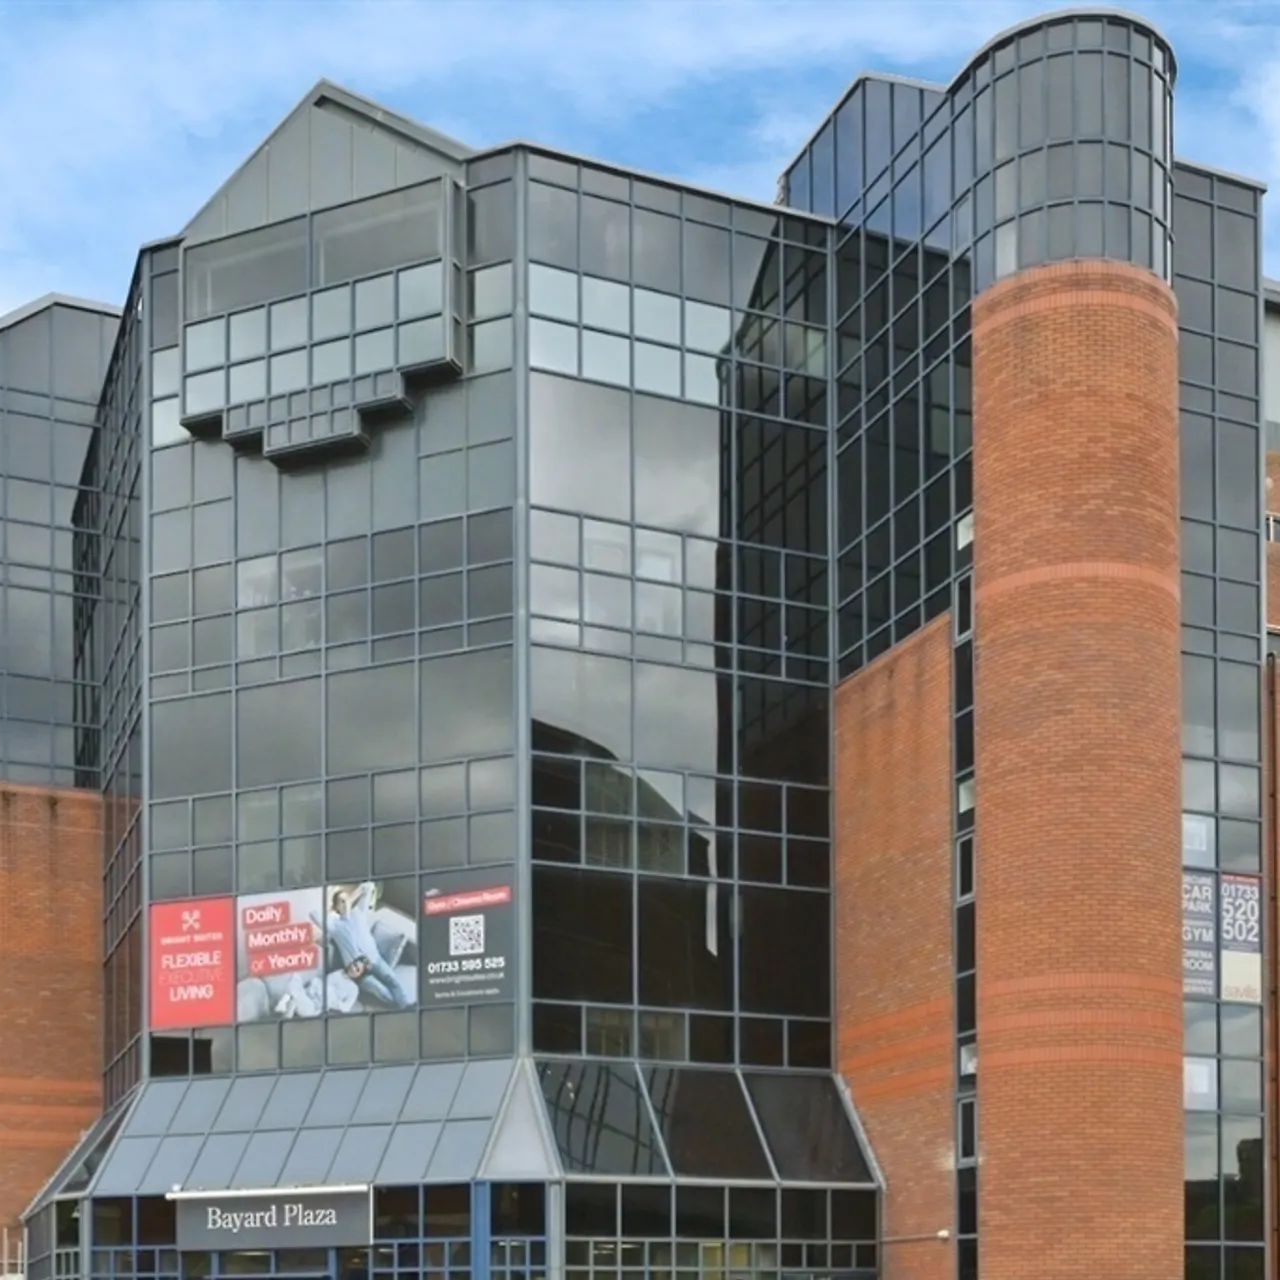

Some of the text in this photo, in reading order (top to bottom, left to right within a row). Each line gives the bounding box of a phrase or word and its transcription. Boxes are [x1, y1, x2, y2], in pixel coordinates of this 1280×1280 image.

[1182, 884, 1212, 900] CAR
[1221, 882, 1260, 900] 01733
[1182, 900, 1212, 913] PARK
[1221, 898, 1260, 921] 520
[1182, 926, 1214, 942] GYM
[1222, 919, 1260, 942] 502
[161, 950, 222, 969] FLEXIBLE
[268, 950, 314, 970] Yearly
[428, 959, 459, 974] 01733
[170, 983, 214, 1002] LIVING
[206, 1203, 338, 1233] Bayard Plaza
